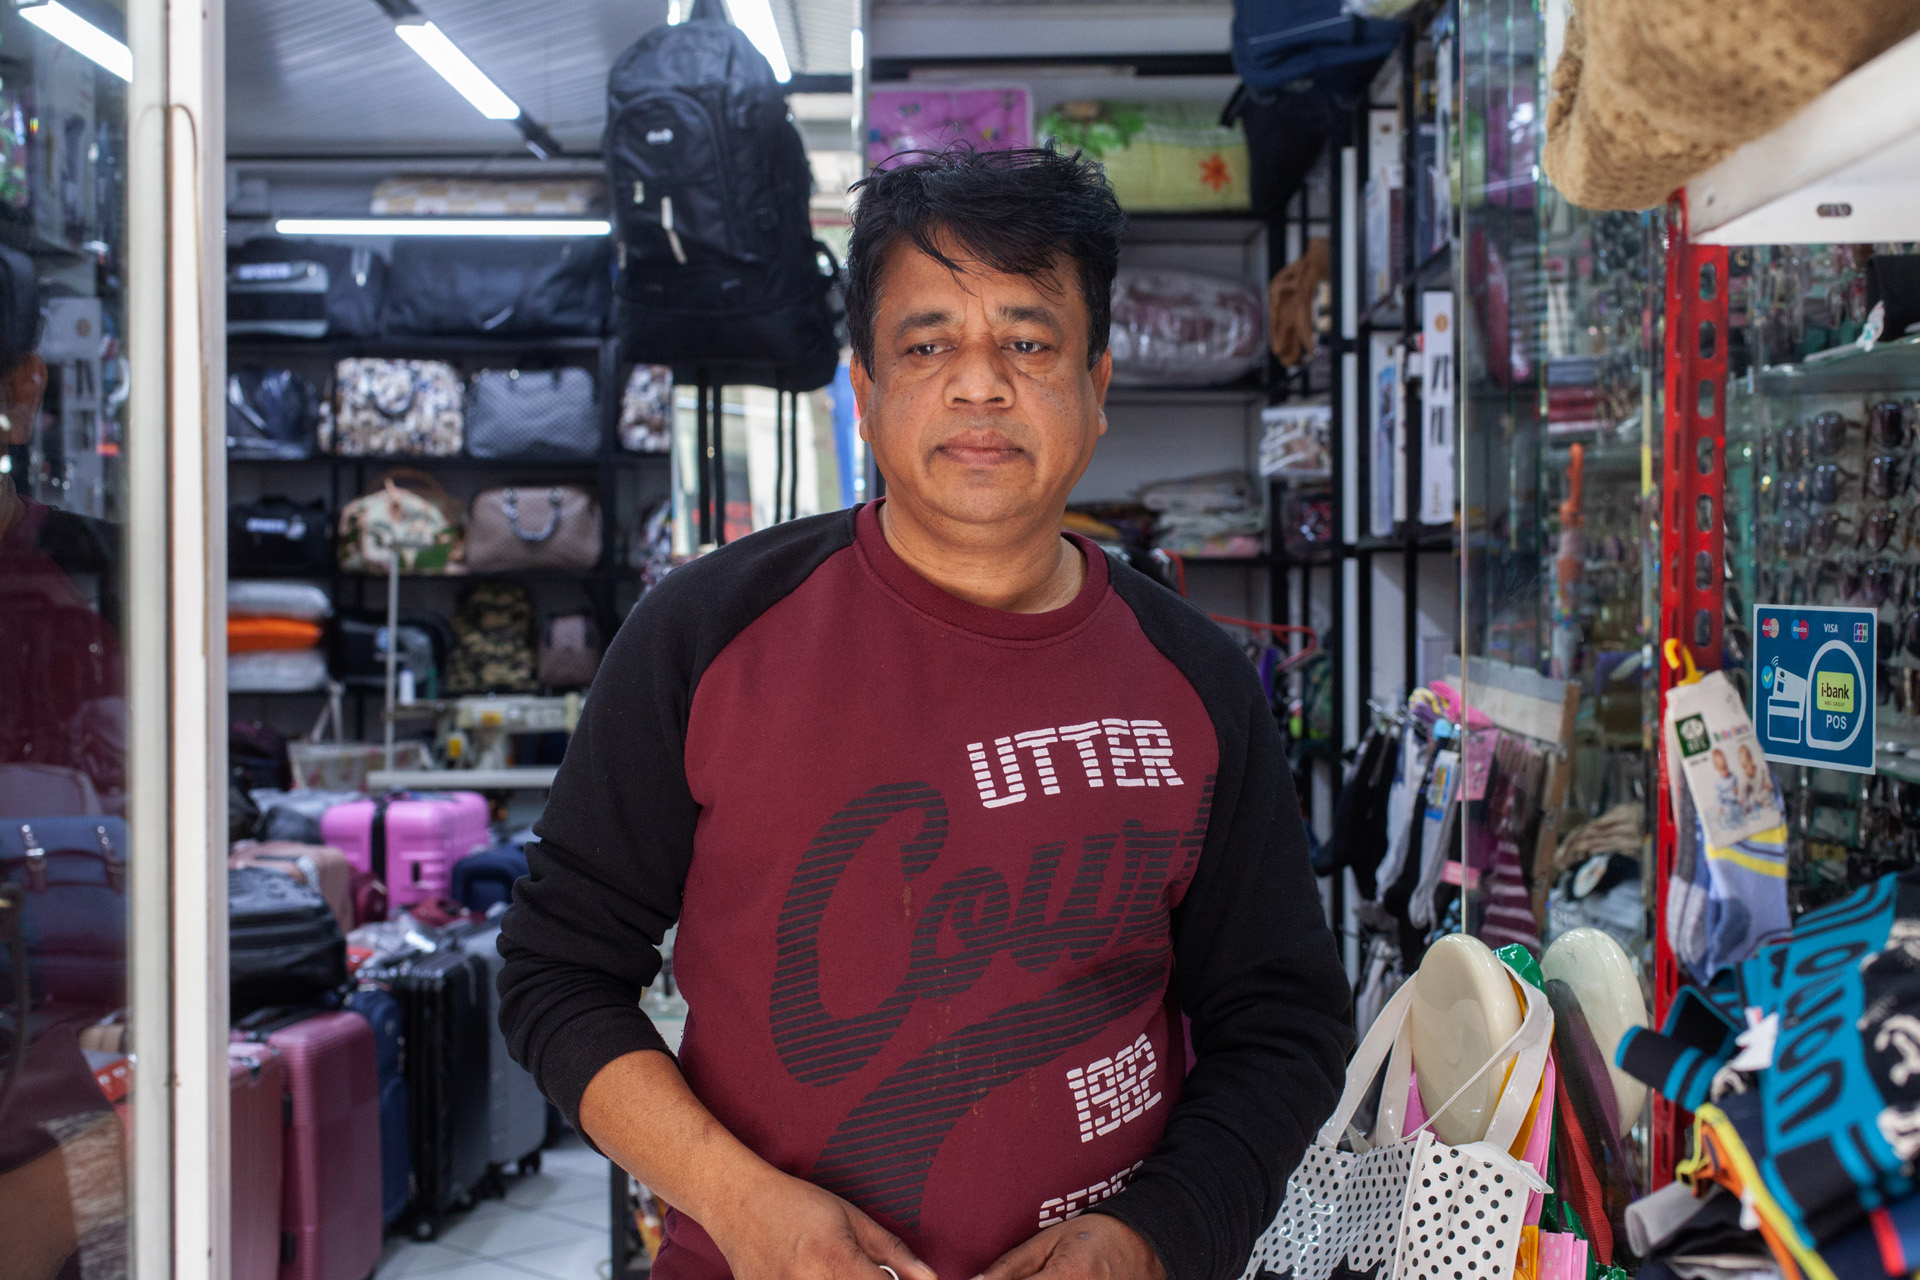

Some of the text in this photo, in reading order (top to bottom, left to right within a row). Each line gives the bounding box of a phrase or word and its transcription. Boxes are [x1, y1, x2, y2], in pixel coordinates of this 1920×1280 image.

[1824, 623, 1838, 633] VISA
[1821, 682, 1850, 700] i-bank
[1826, 714, 1847, 730] POS
[967, 718, 1184, 808] UTTER
[1066, 1032, 1162, 1143] 1982
